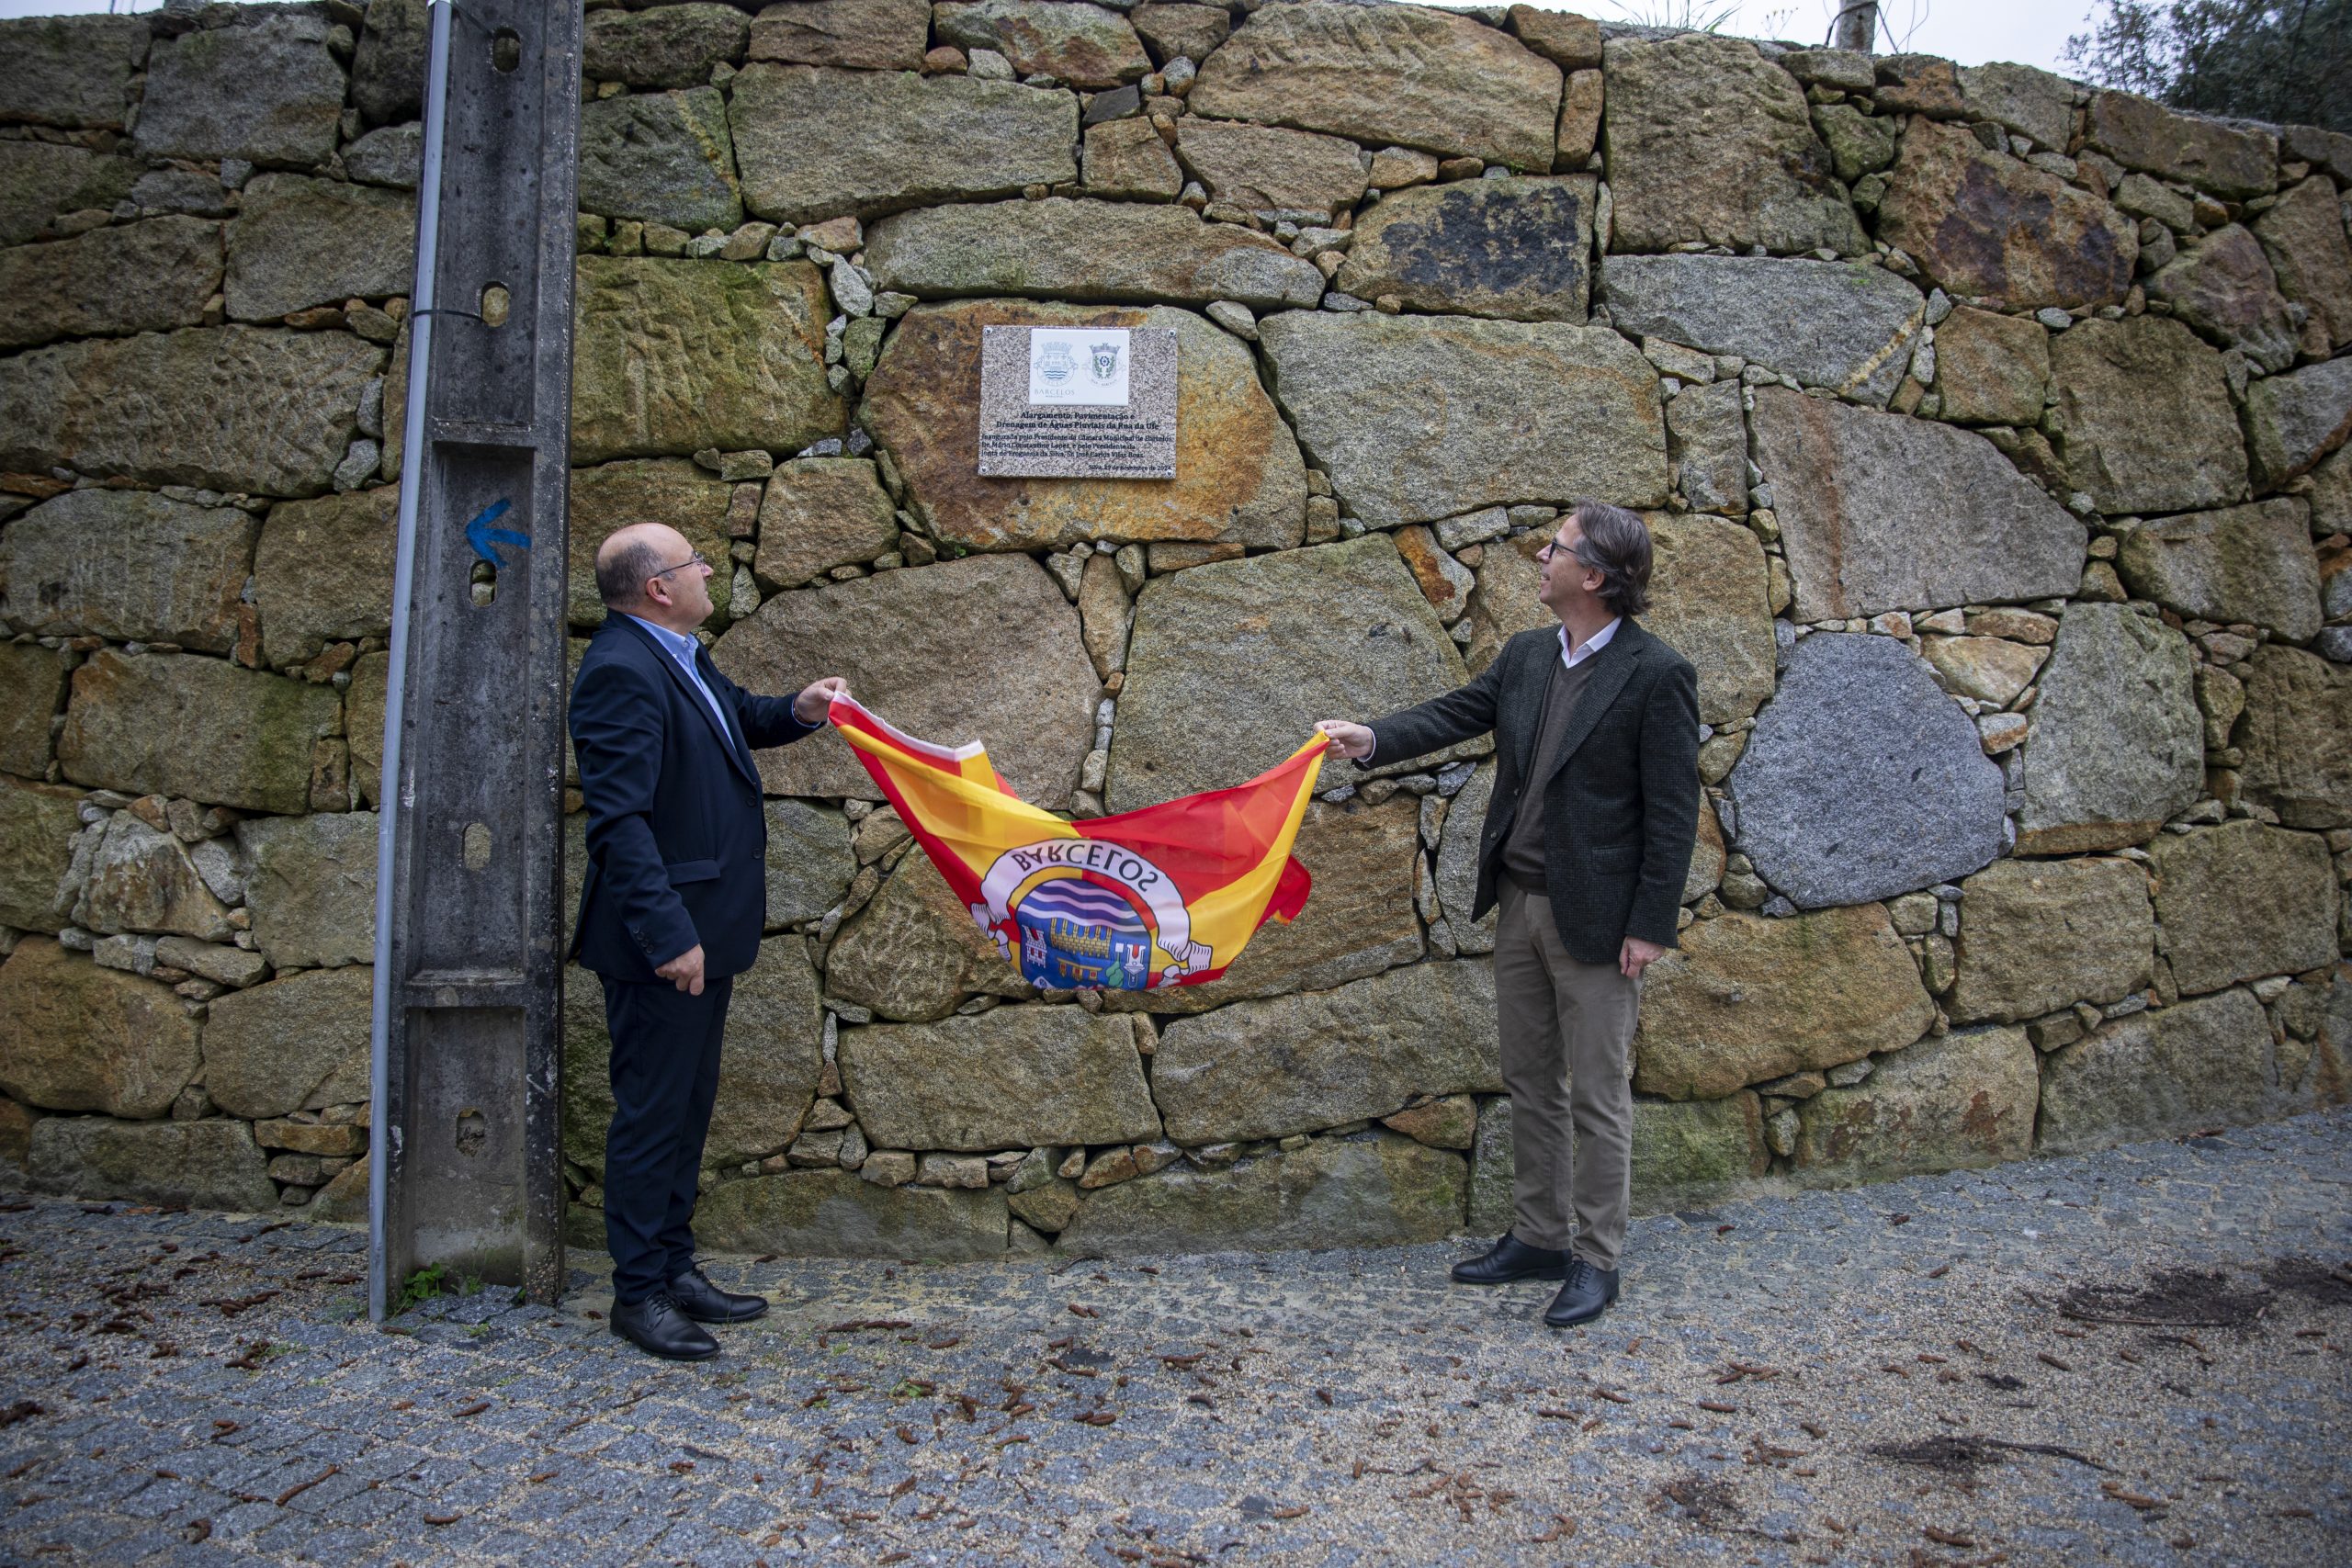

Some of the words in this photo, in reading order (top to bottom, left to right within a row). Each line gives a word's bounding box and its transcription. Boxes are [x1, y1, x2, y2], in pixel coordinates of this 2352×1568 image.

[1021, 412, 1073, 420] Alargamento,
[996, 421, 1036, 429] Drenagem
[1049, 420, 1072, 429] Águas
[1019, 434, 1033, 442] pelo
